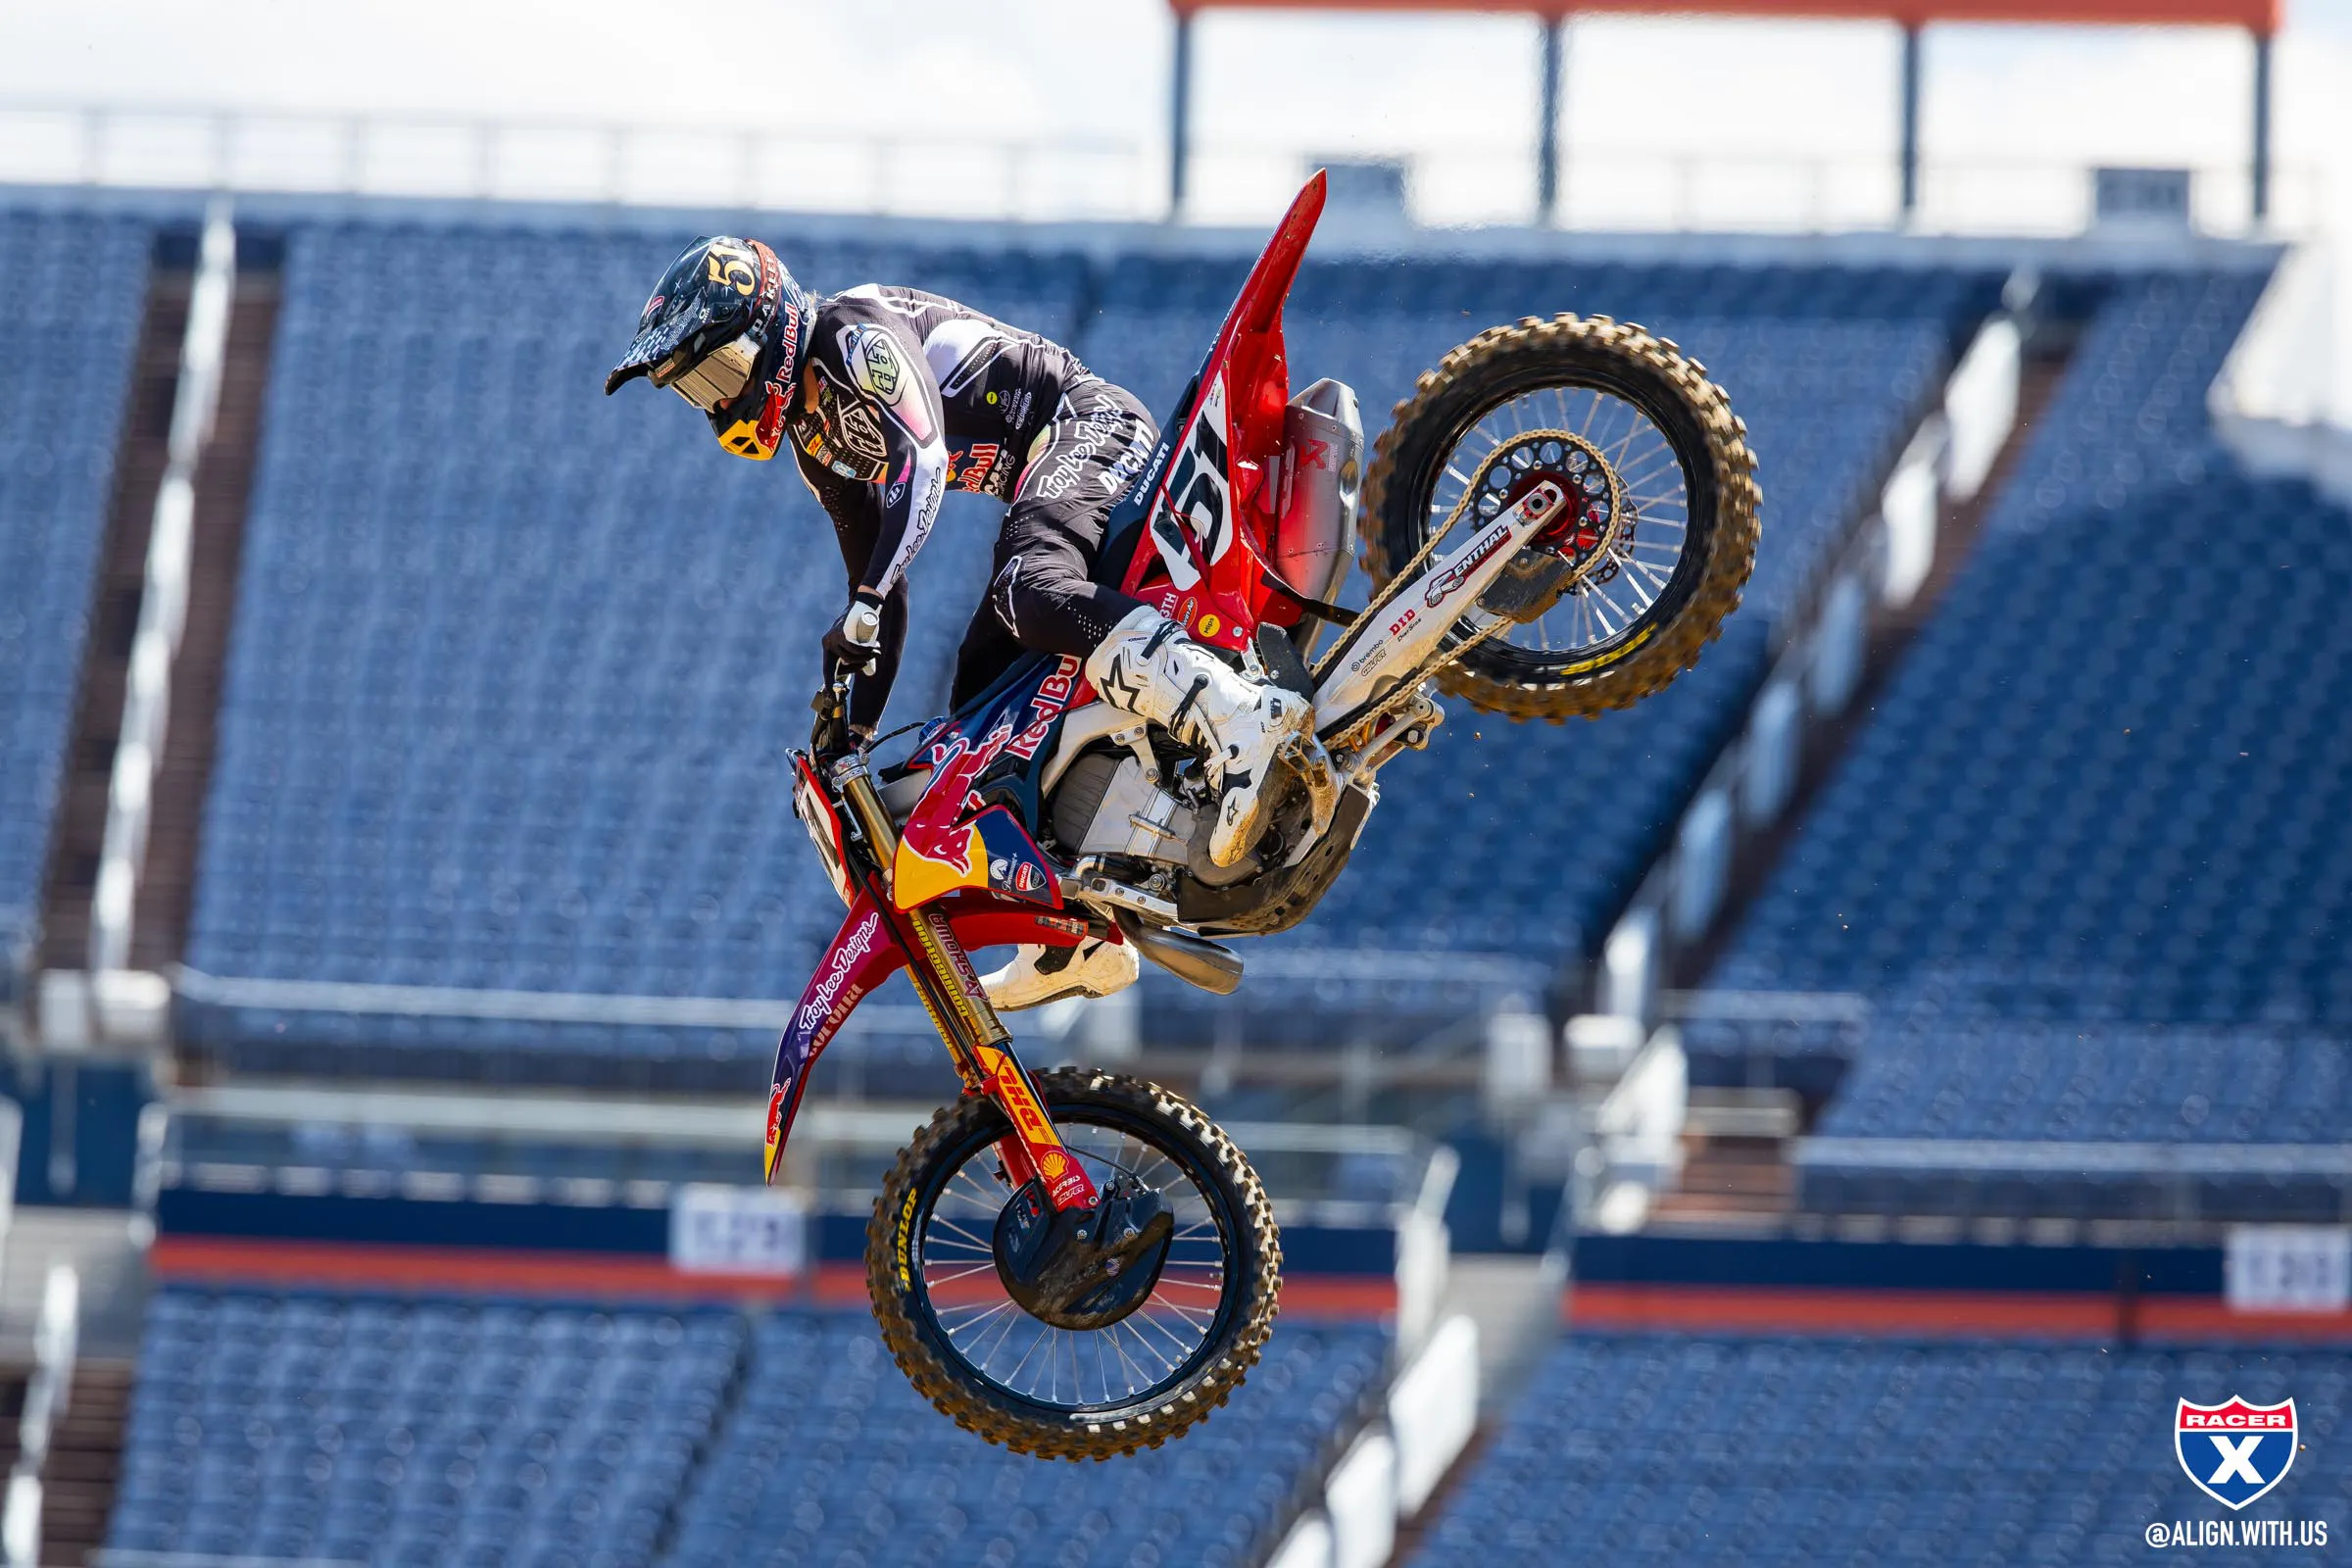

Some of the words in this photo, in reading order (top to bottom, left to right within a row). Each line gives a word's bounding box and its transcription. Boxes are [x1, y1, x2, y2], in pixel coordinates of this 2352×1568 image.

[784, 301, 799, 344] Bull
[776, 338, 797, 383] Red
[960, 442, 1000, 482] Bull
[1056, 435, 1097, 466] Lee
[1037, 462, 1080, 499] Troy
[1134, 443, 1169, 507] DUCATI
[1152, 409, 1229, 570] 51
[1426, 525, 1511, 608] RENTHAL
[1202, 617, 1215, 634] Mips
[1358, 639, 1384, 663] brembo
[1004, 697, 1062, 761] Red
[1039, 654, 1082, 704] Bu
[1018, 862, 1029, 890] DUCATI
[833, 912, 880, 975] Designs
[929, 913, 973, 978] SHOWA
[824, 963, 847, 1003] Lee
[800, 1000, 833, 1032] Troy
[1000, 1068, 1042, 1133] DHL
[897, 1188, 918, 1288] DUNLOP
